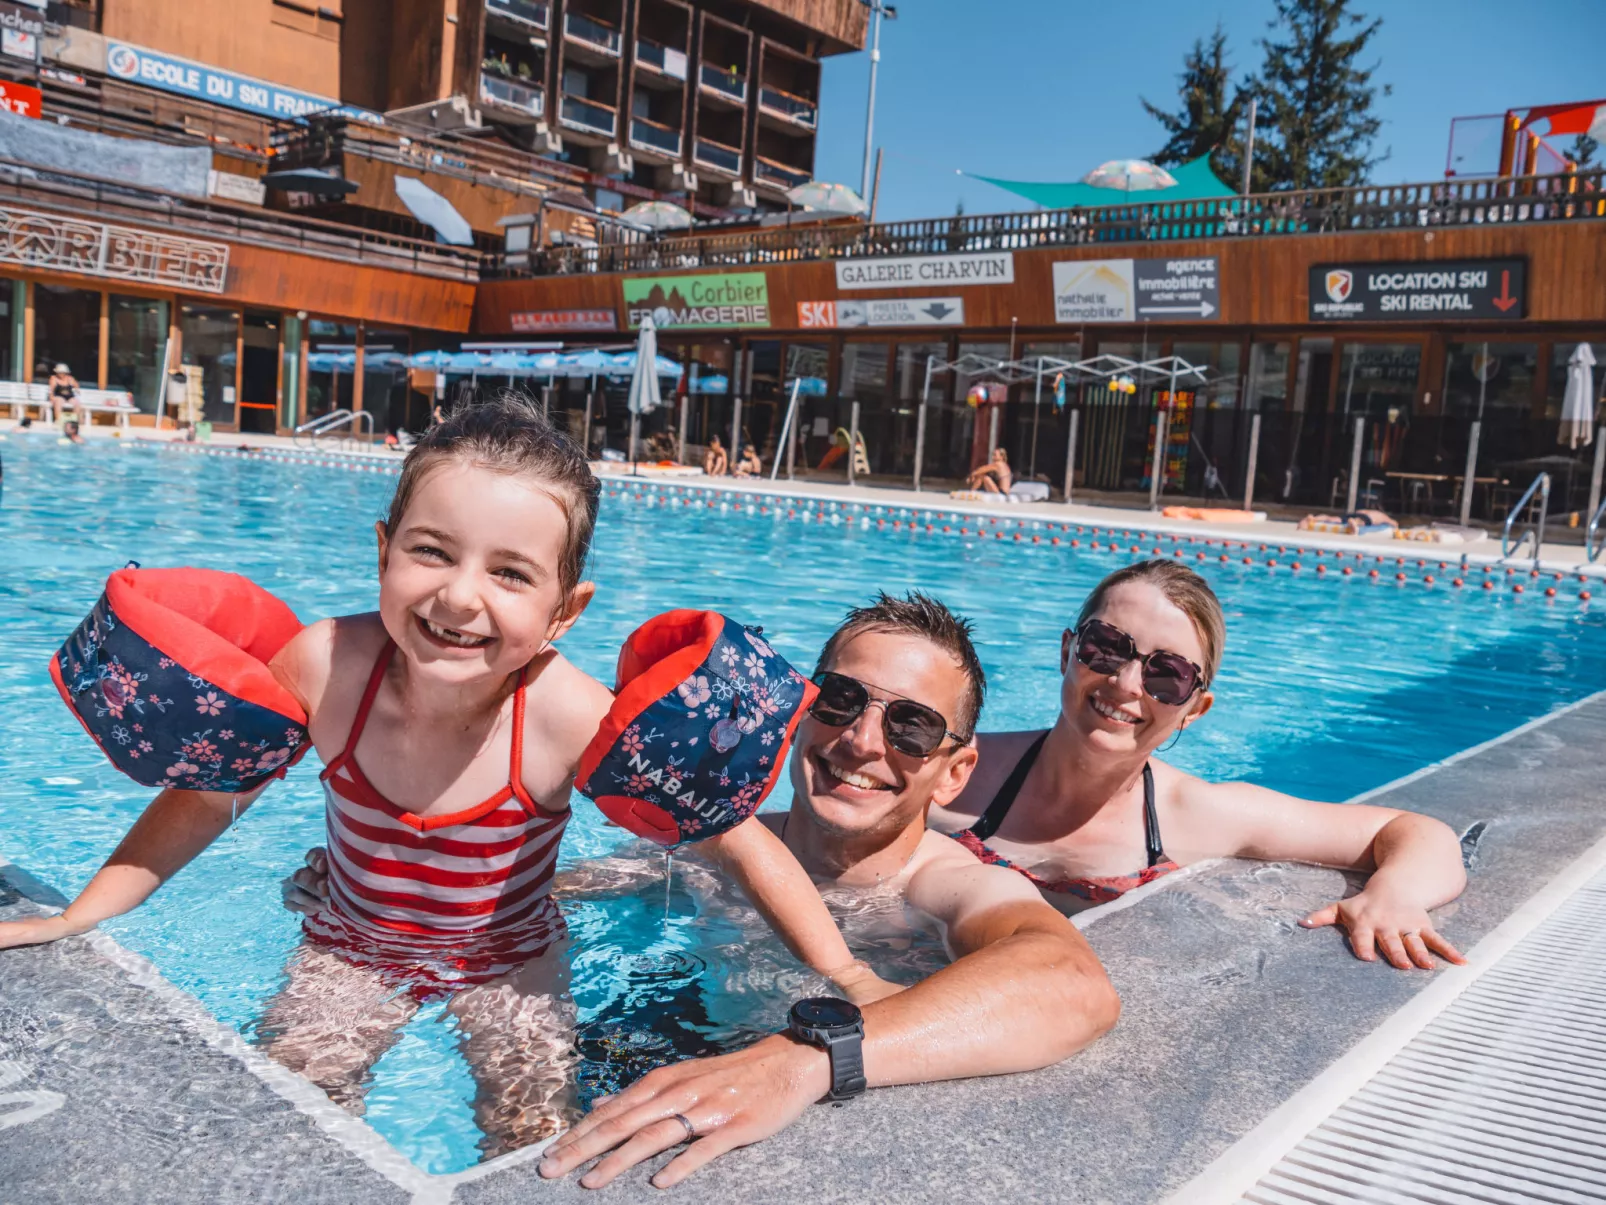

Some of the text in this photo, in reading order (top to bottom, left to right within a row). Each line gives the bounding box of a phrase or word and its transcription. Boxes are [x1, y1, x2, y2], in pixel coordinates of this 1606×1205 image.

[141, 57, 201, 92] ECOLE
[207, 75, 234, 100] DU
[239, 85, 270, 109] SKI
[842, 258, 1006, 284] GALERIE CHARVIN
[1368, 270, 1488, 292] LOCATION SKI
[691, 280, 766, 303] Corbier
[1380, 293, 1473, 311] SKI RENTAL
[800, 303, 835, 327] SKI
[627, 752, 727, 825] NABAIJI
